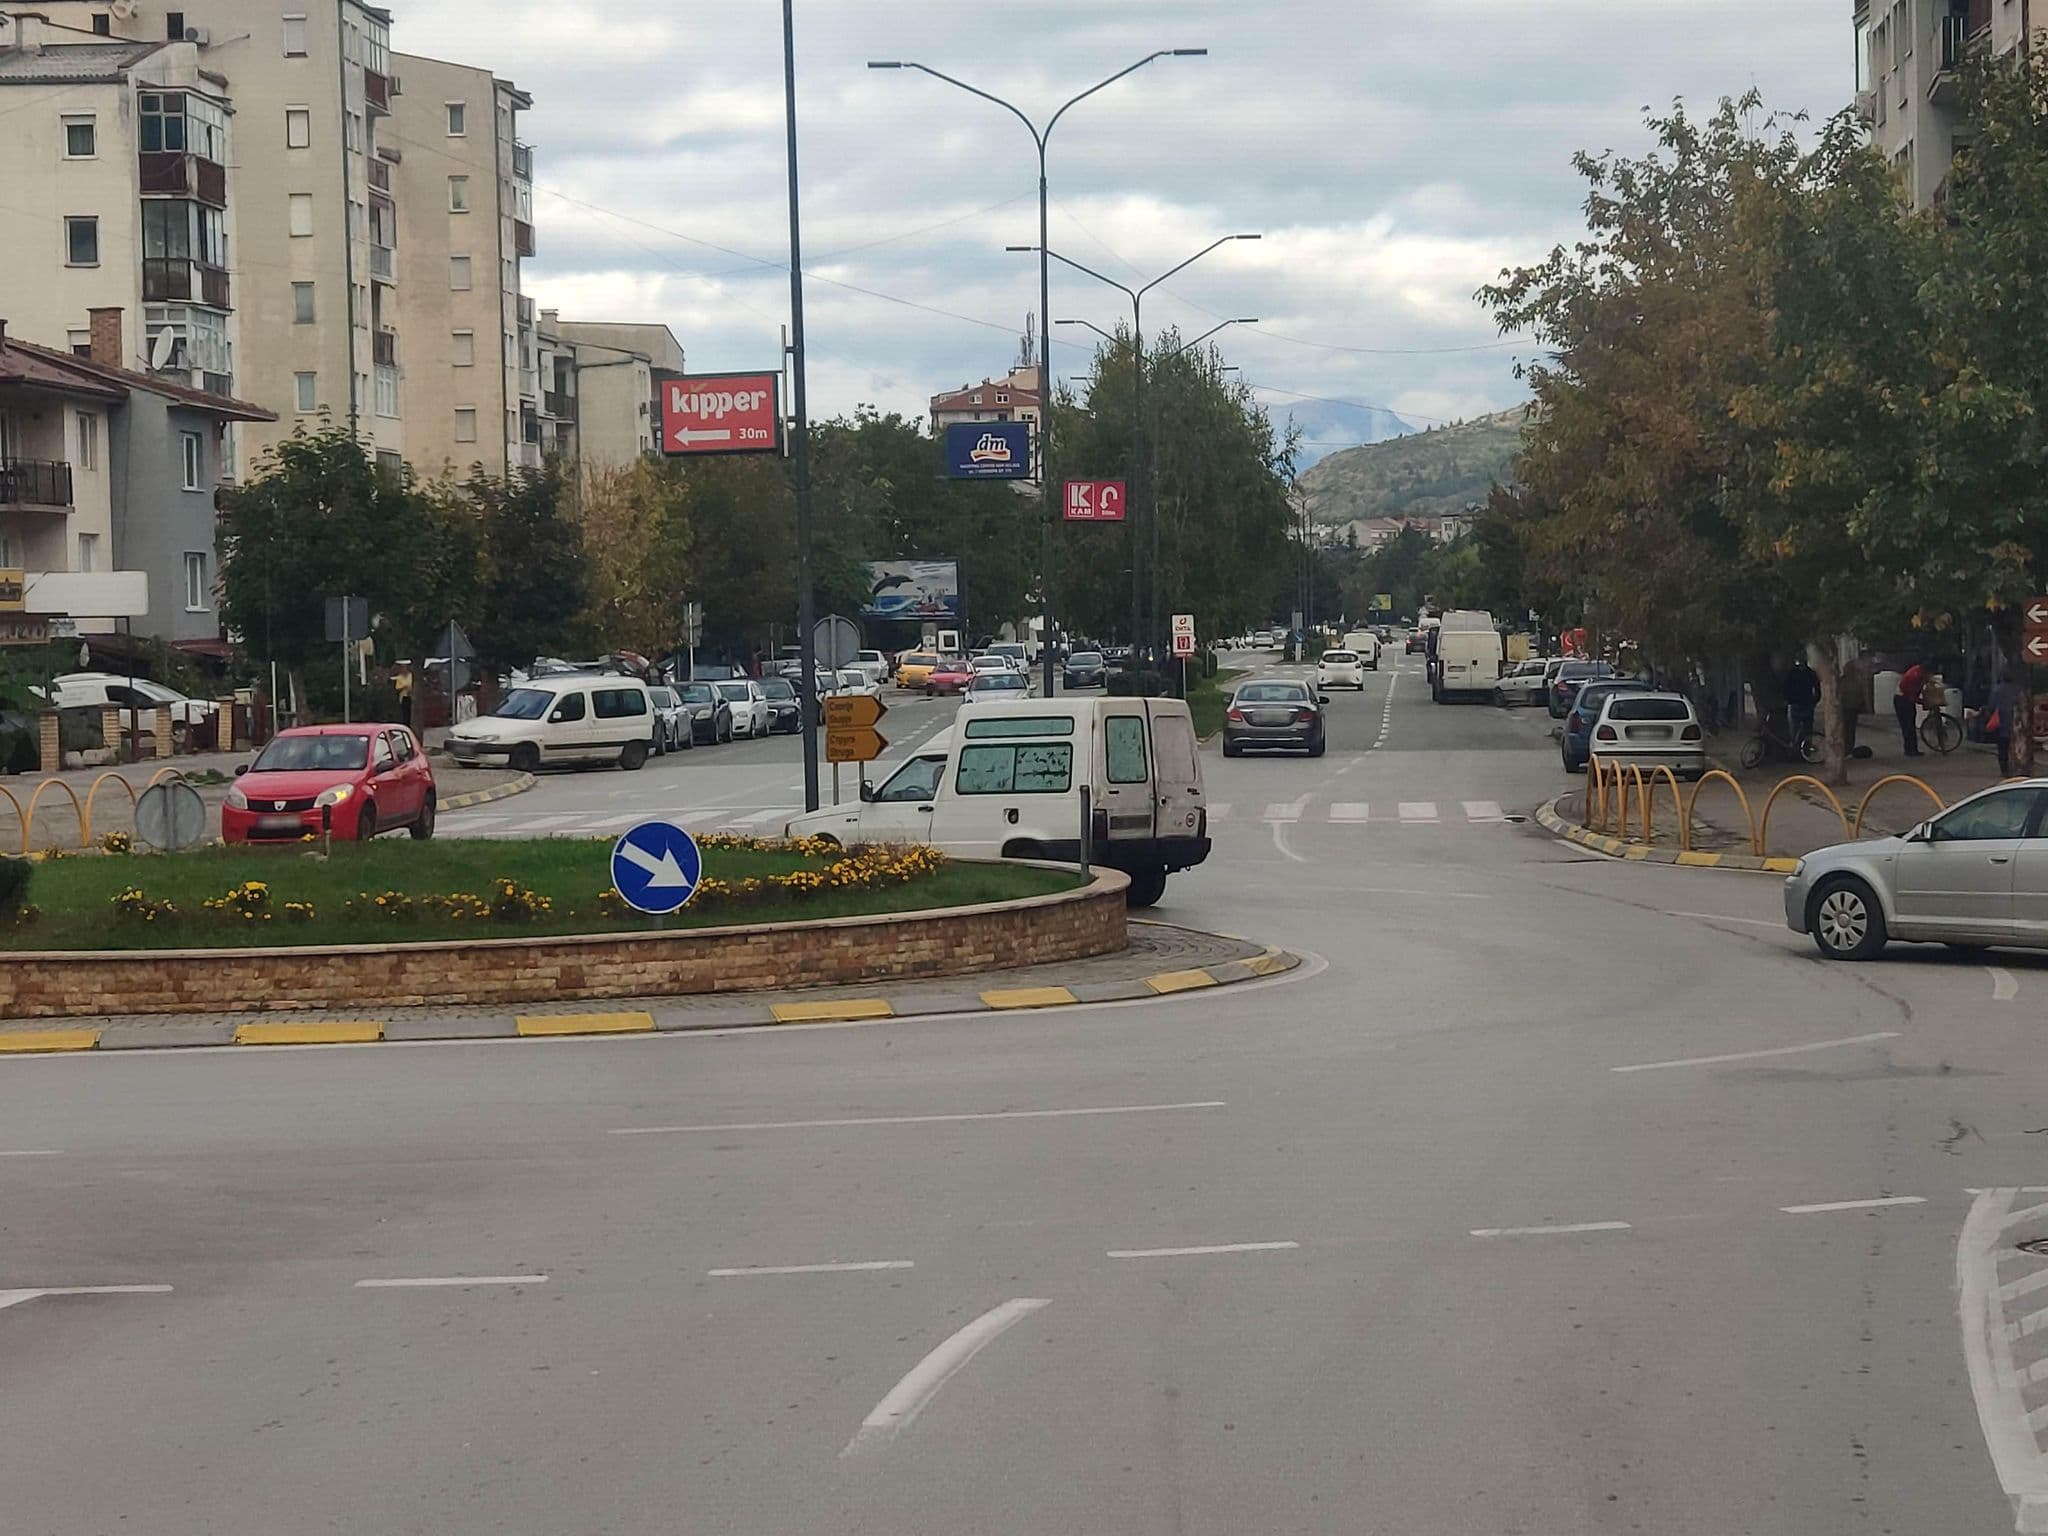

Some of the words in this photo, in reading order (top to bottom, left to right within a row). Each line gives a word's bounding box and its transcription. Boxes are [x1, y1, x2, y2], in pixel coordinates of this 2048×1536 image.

[671, 386, 767, 420] kipper
[739, 428, 768, 439] 30m
[978, 433, 1005, 451] dm
